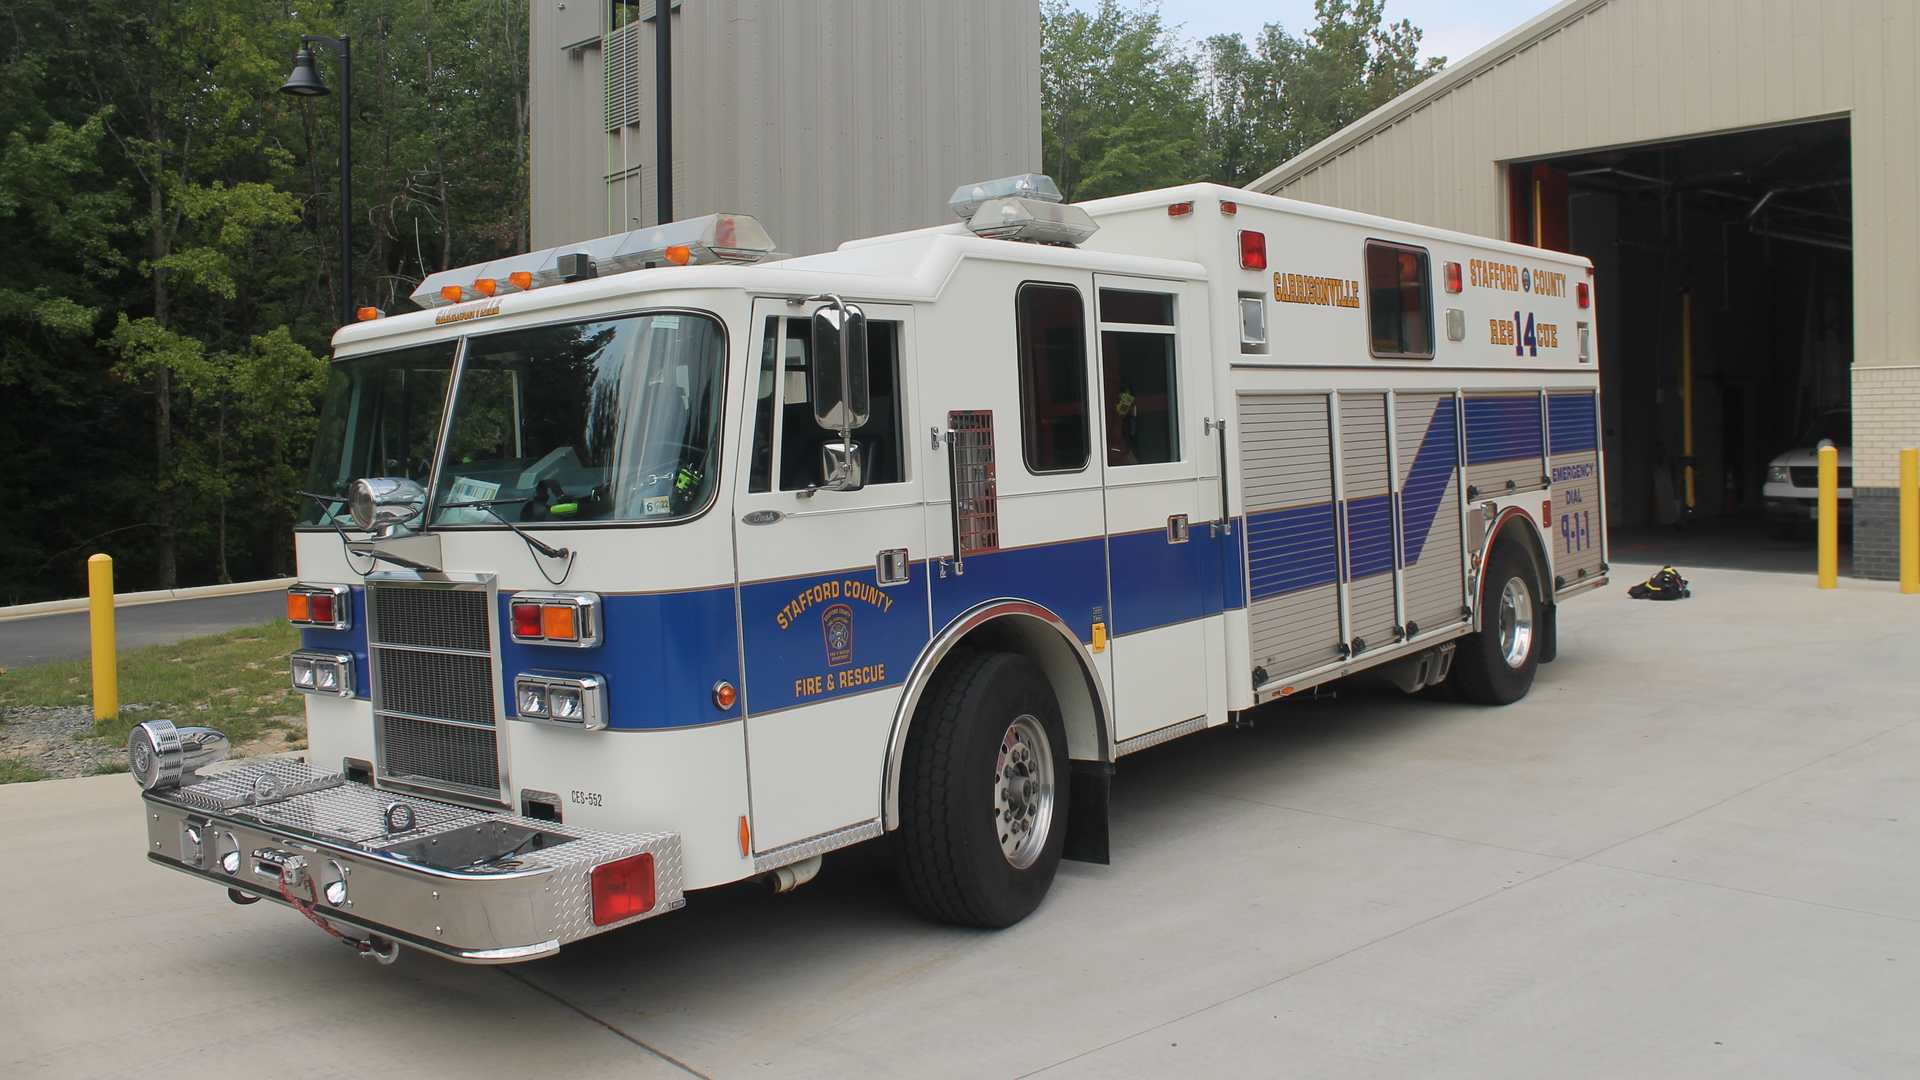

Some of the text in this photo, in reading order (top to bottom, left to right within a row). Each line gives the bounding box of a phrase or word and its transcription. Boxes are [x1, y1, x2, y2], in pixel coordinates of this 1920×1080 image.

[1273, 271, 1360, 308] GARRISONVILLE
[1470, 258, 1566, 298] STAFFORD COUNTY
[1552, 462, 1594, 483] EMERGENCY
[646, 500, 669, 512] 6 22
[1566, 489, 1582, 505] DIAL
[1561, 510, 1590, 554] 9-1-1
[776, 580, 894, 630] STAFFORD COUNTY
[795, 663, 885, 698] FIRE & RESCUE
[571, 790, 603, 807] CES-552
